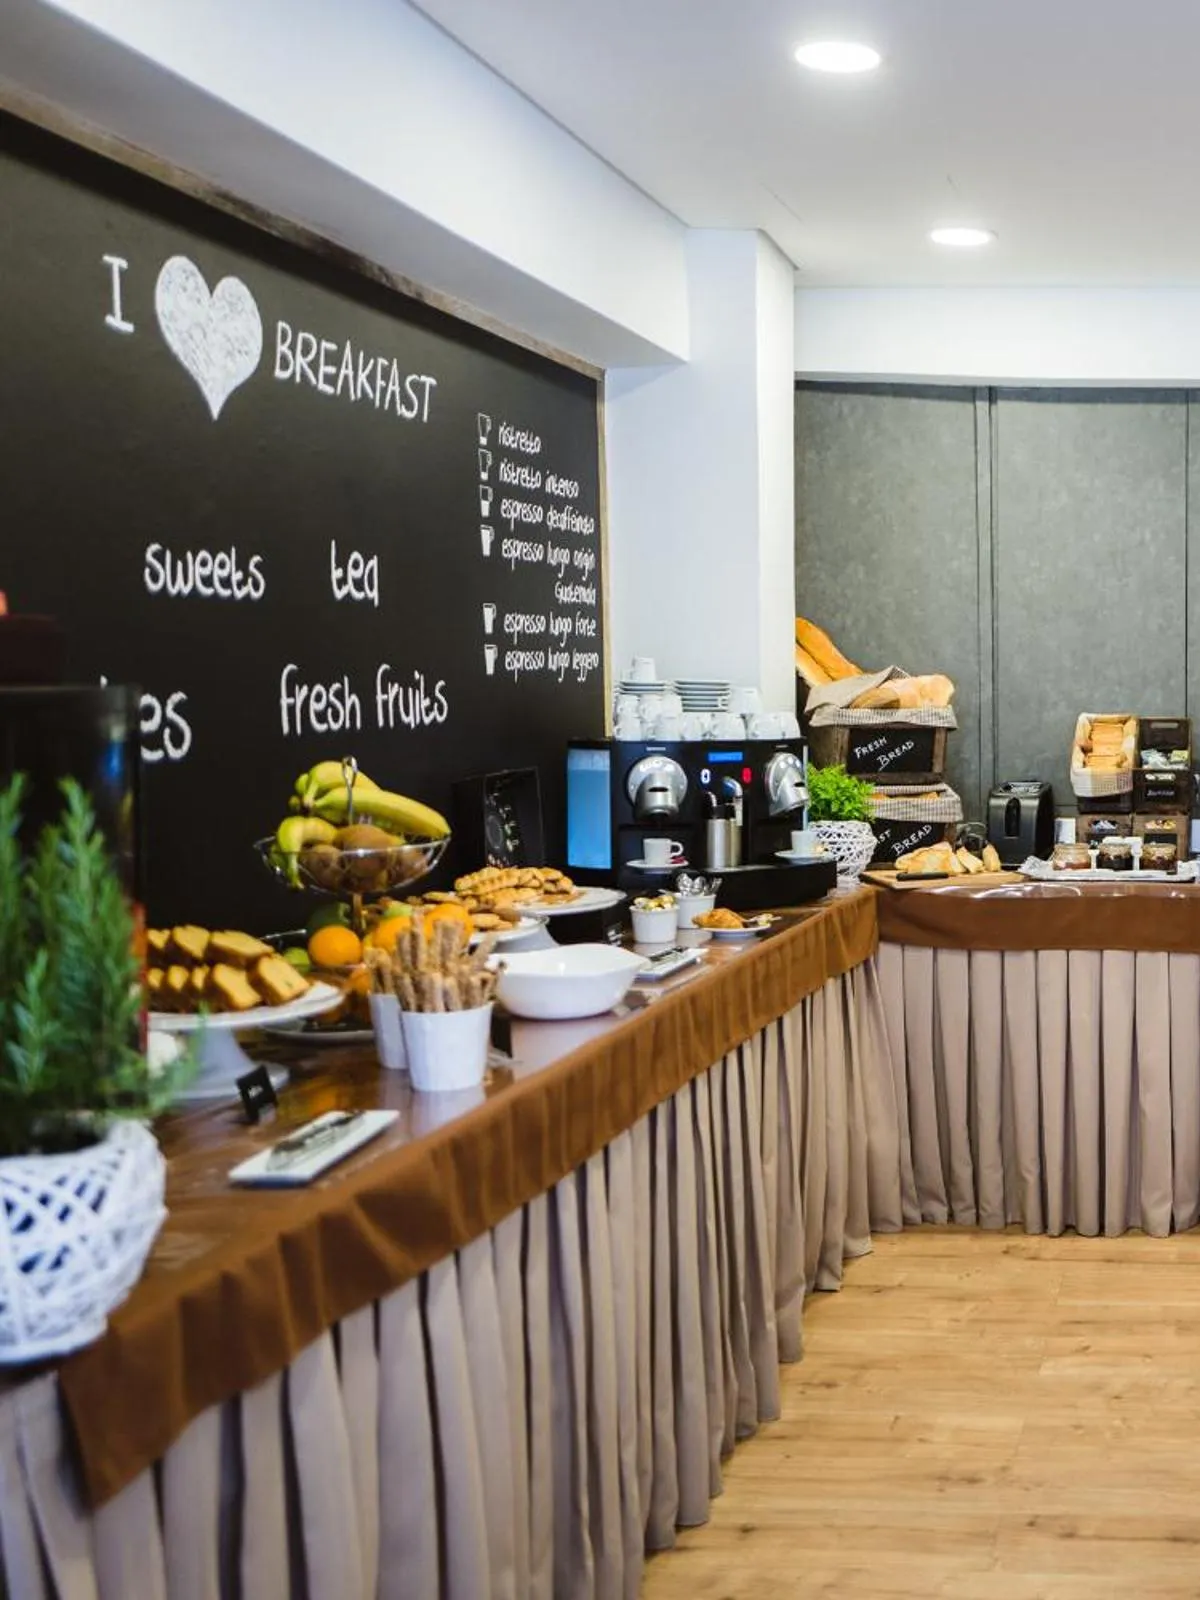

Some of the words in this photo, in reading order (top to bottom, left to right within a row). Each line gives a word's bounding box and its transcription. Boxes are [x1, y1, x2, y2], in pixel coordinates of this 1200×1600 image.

[102, 254, 134, 332] I
[274, 320, 438, 422] BREAKFAST
[498, 421, 541, 455] ristretto
[498, 458, 542, 489] ristretto
[545, 470, 580, 499] intenso
[500, 498, 543, 532] espresso
[144, 542, 266, 600] sweets
[330, 539, 380, 608] tea
[501, 538, 544, 571] espresso
[547, 541, 571, 578] lungo
[503, 612, 547, 645] espresso
[549, 611, 572, 648] lungo
[575, 611, 597, 637] forte
[504, 650, 545, 683] espresso
[547, 647, 570, 683] lungo
[572, 648, 599, 682] leggero
[279, 663, 361, 737] fresh
[376, 663, 449, 730] fruits
[853, 736, 888, 759] FRESH
[876, 740, 915, 772] BREAD
[891, 824, 932, 856] BREAD
